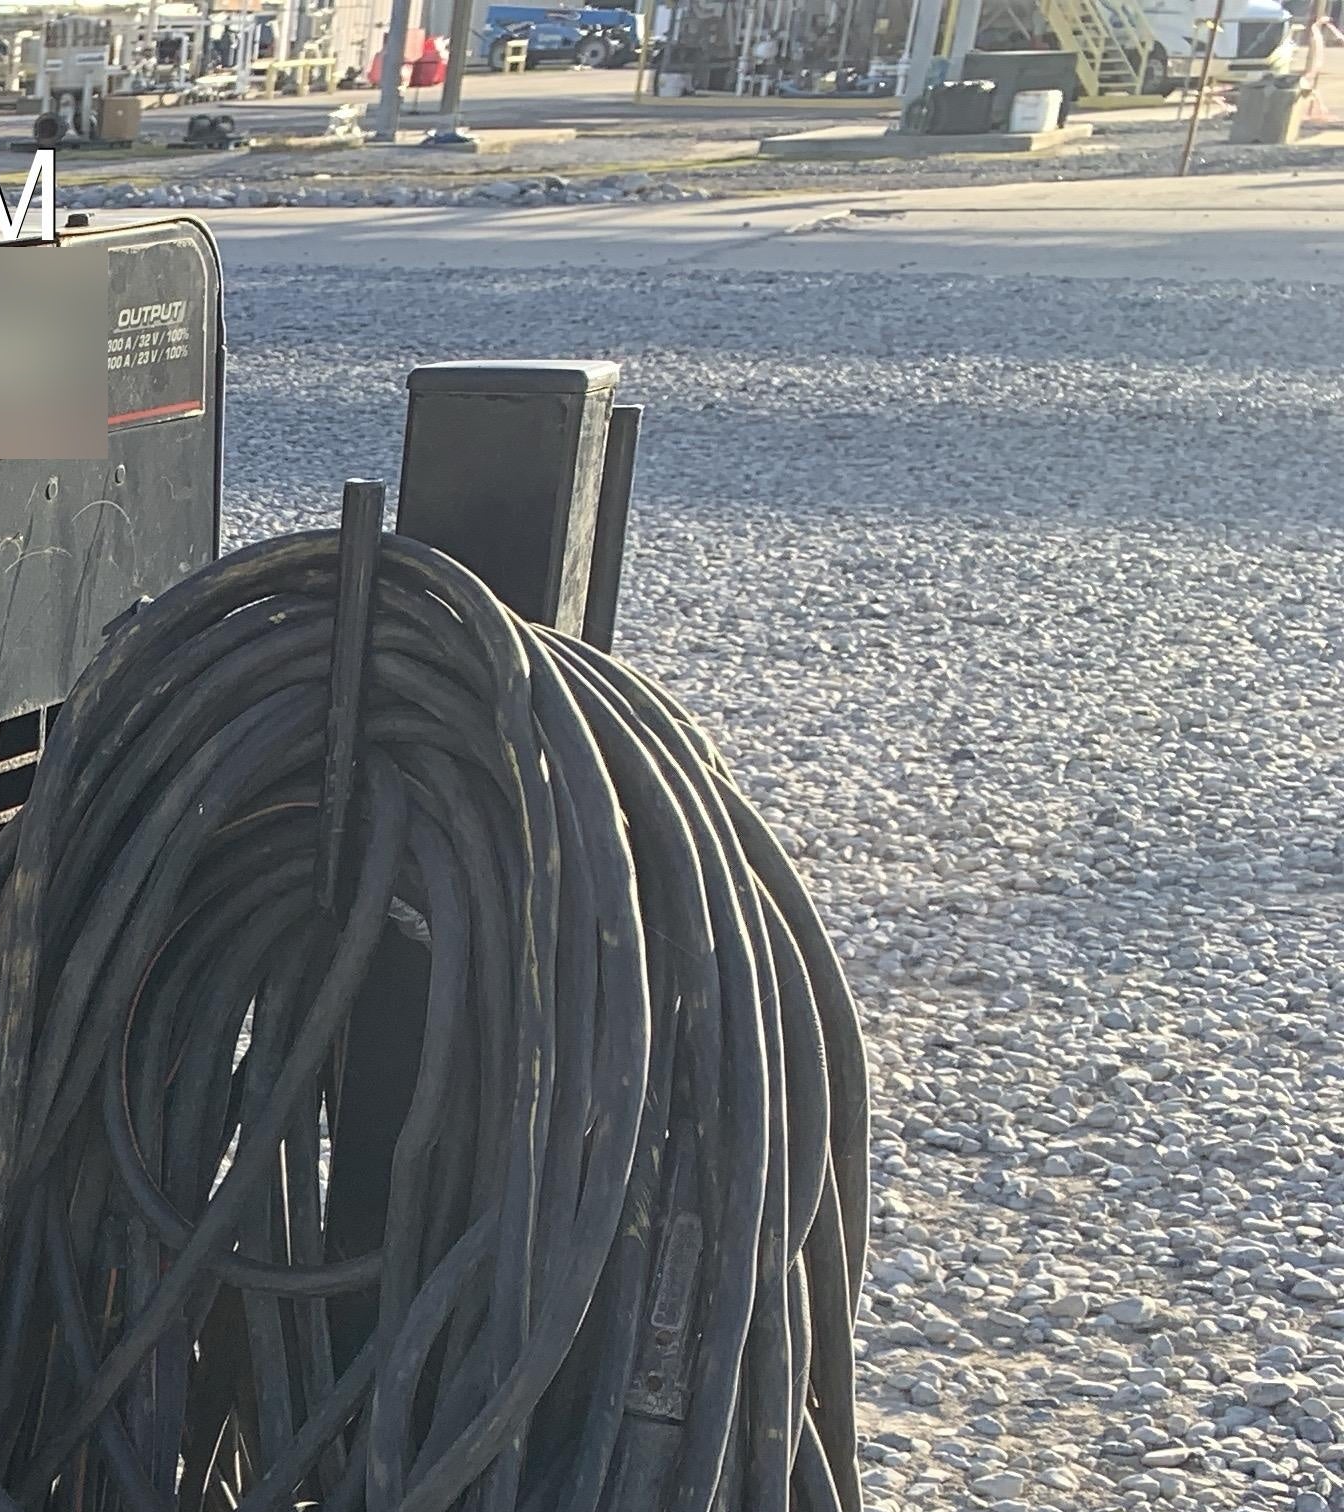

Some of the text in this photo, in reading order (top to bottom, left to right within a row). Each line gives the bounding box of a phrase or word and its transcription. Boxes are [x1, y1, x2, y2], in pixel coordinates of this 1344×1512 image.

[118, 301, 182, 327] OUTPUT
[125, 336, 132, 350] A
[139, 333, 151, 348] 32
[152, 332, 159, 345] V
[167, 328, 189, 343] 100%
[123, 354, 130, 367] A
[137, 351, 149, 365] 23
[151, 349, 158, 362] V
[165, 345, 188, 360] 100%
